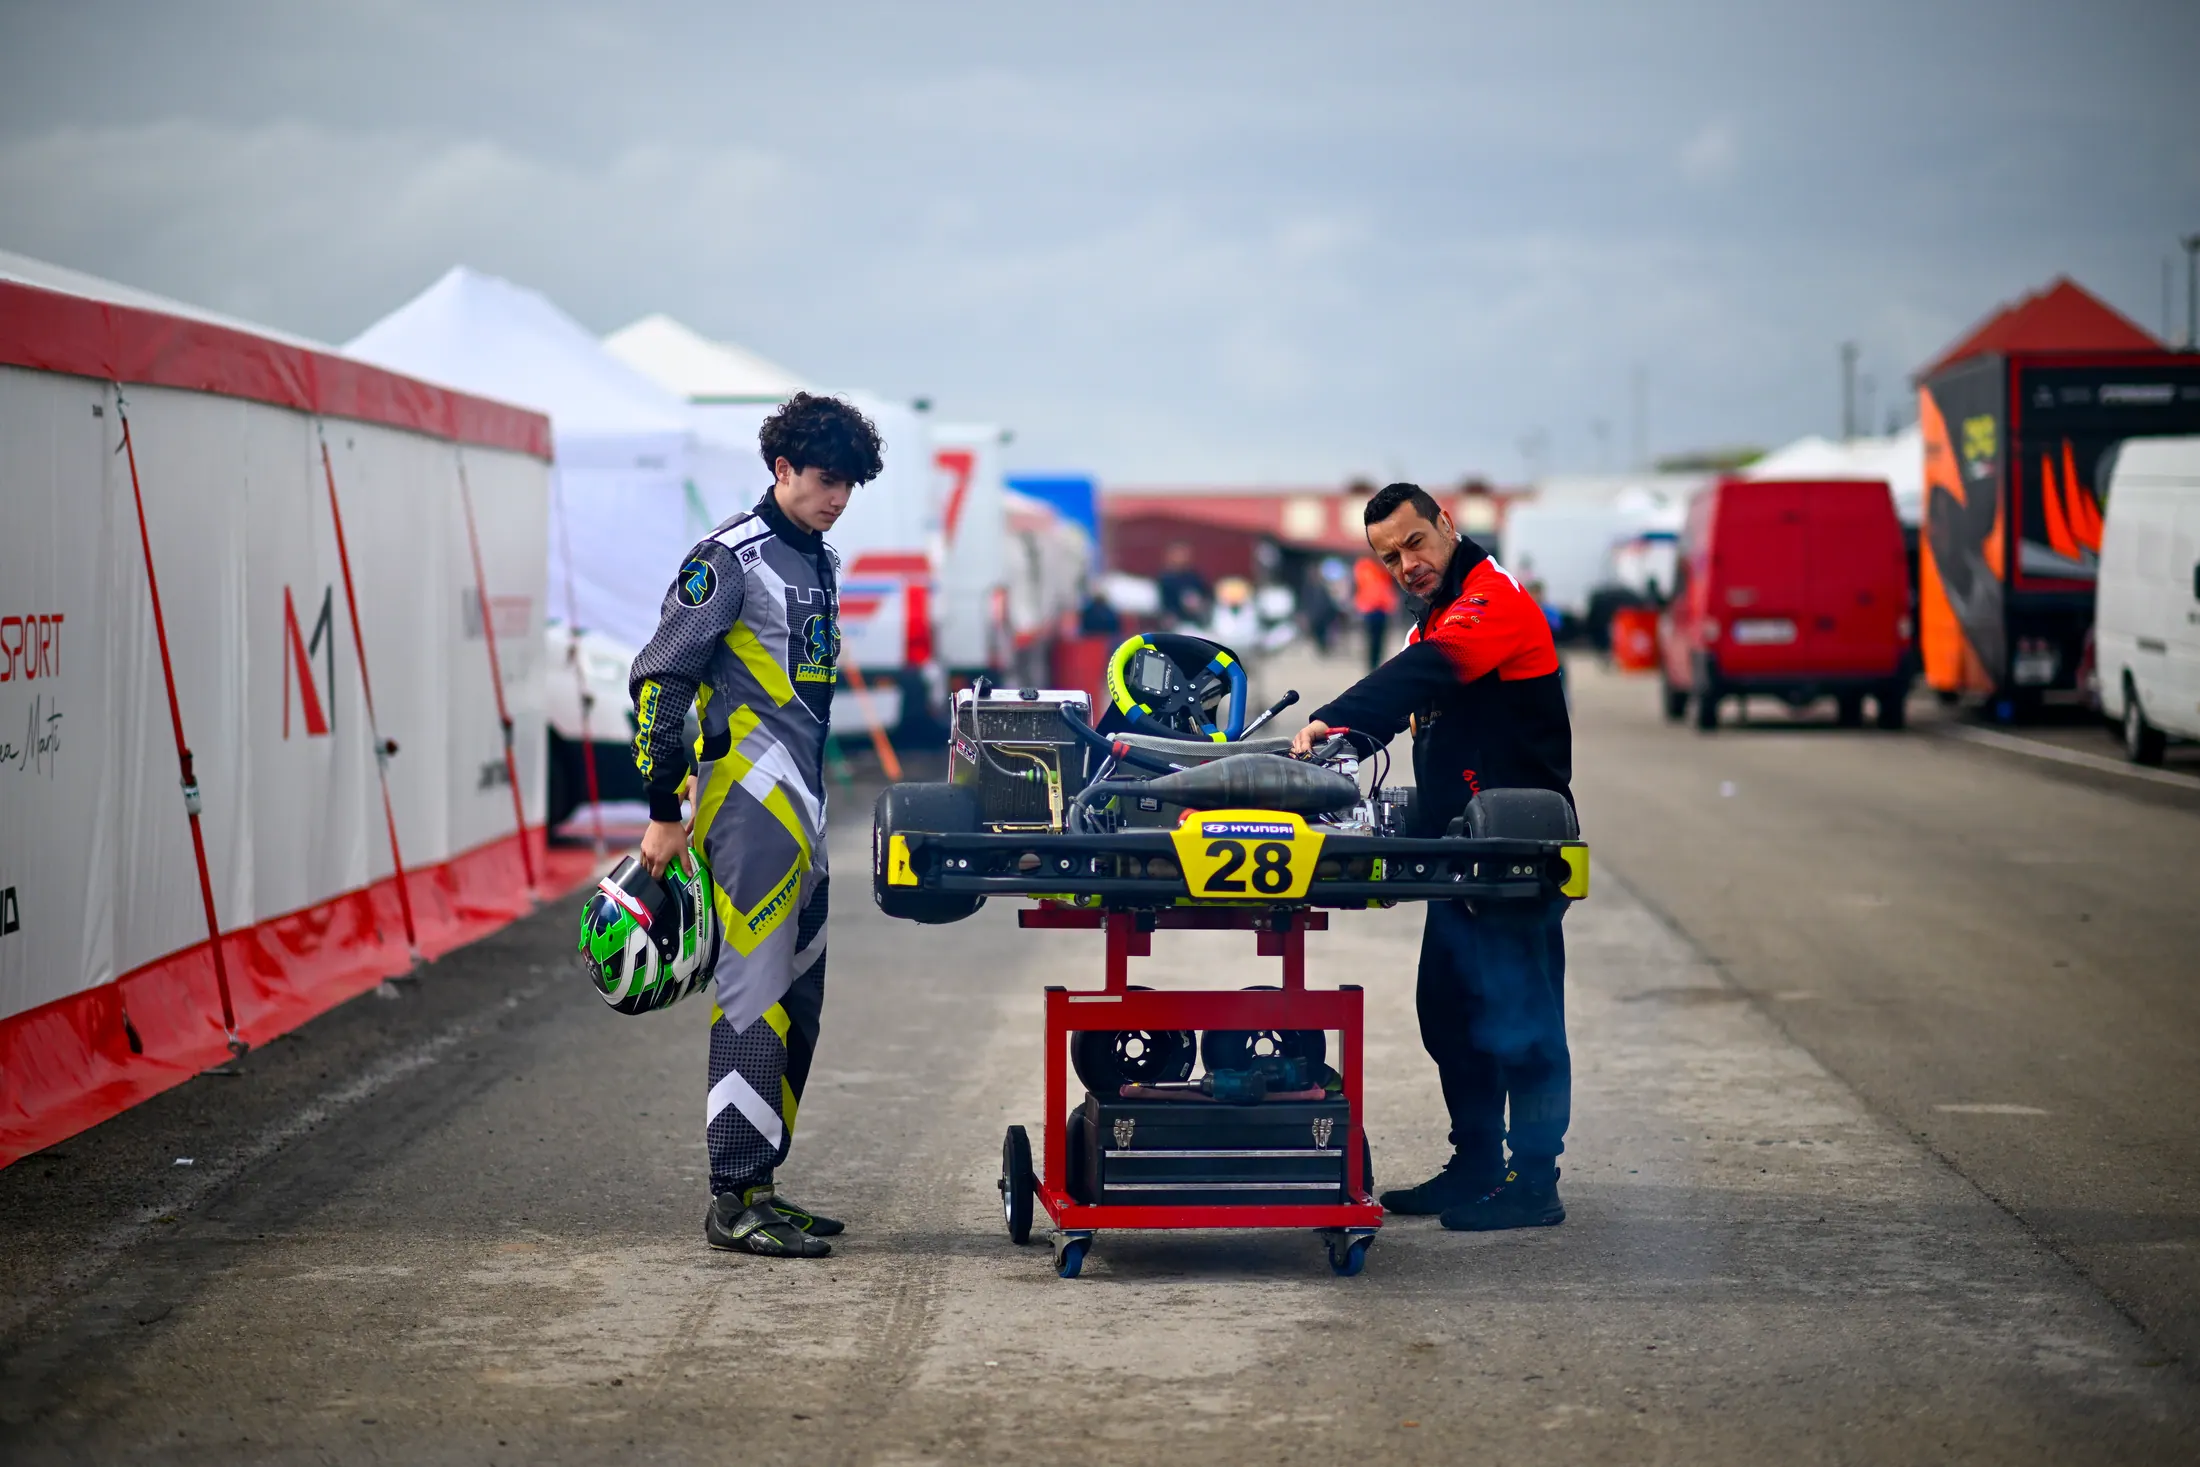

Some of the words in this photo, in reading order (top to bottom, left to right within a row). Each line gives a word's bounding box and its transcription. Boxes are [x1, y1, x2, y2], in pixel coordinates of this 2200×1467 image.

[0, 613, 65, 683] SPORT
[1231, 825, 1293, 834] HYUNDAI
[1203, 840, 1294, 895] 28
[747, 867, 801, 932] PANTAN
[753, 912, 778, 936] RACING
